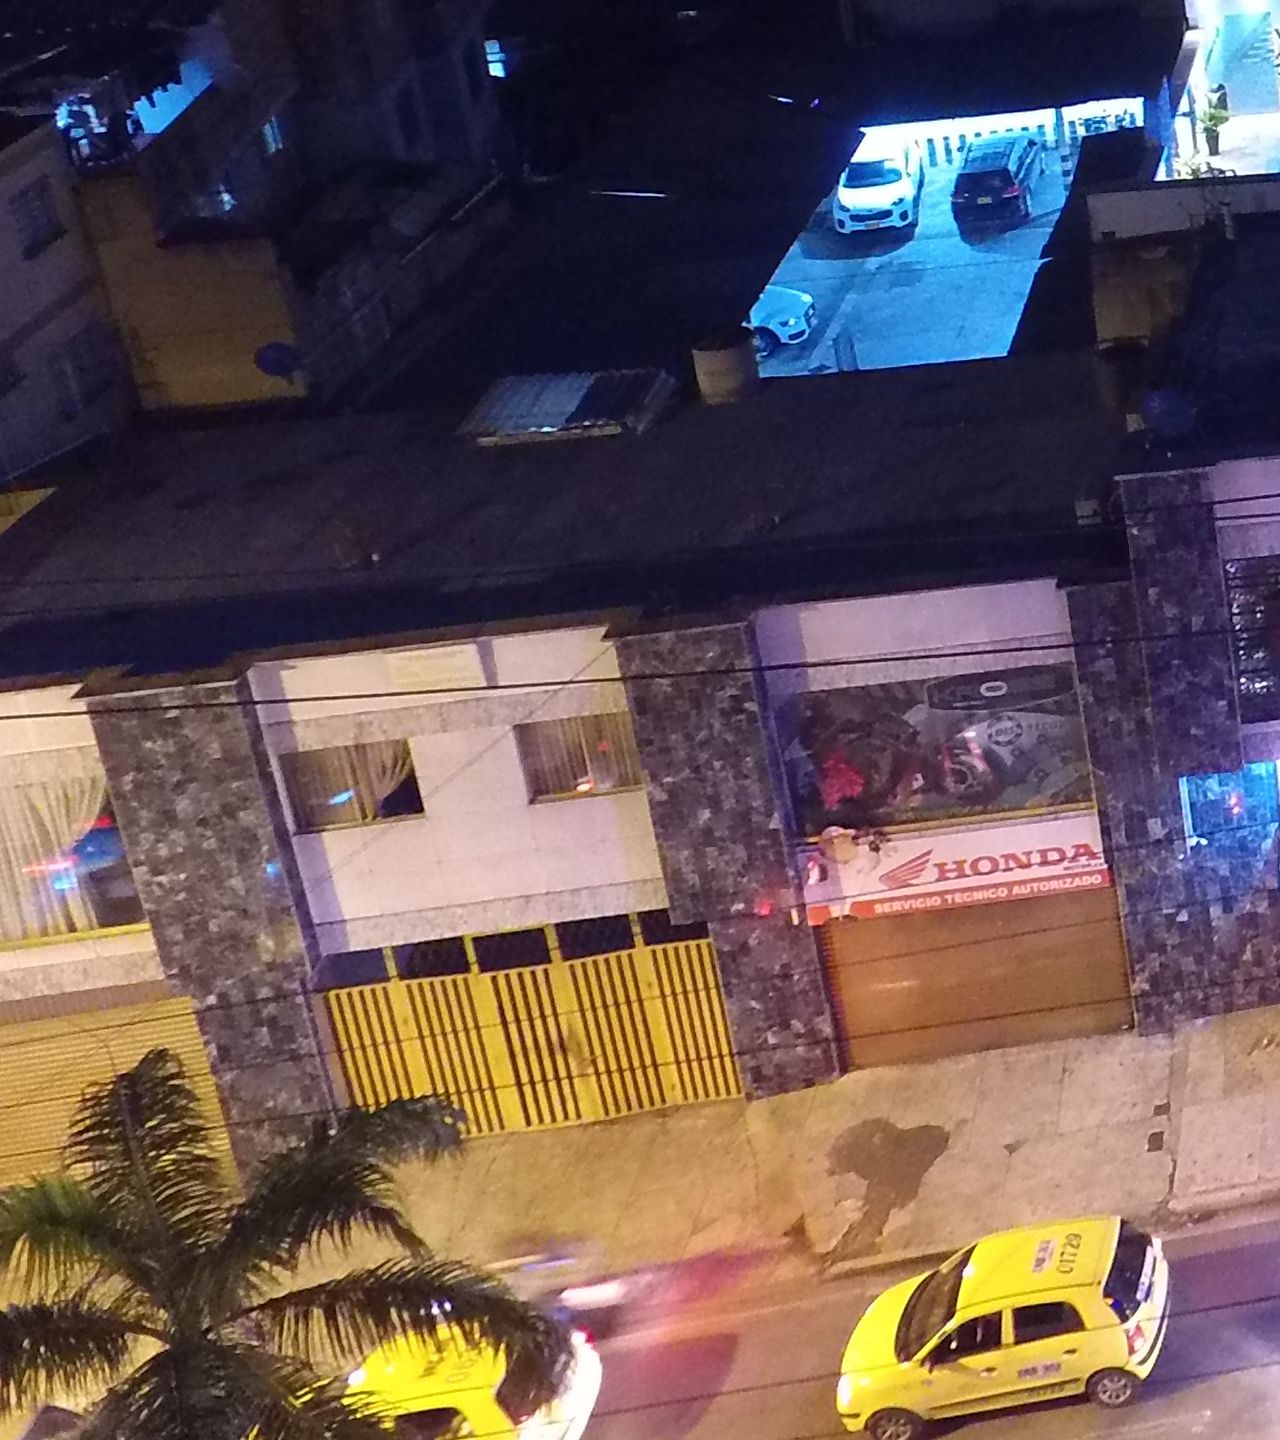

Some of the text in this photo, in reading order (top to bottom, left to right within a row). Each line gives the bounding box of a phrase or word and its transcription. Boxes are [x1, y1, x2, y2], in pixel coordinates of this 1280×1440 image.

[932, 842, 1101, 881] HONDA
[873, 897, 941, 915] SERVICIO
[1012, 873, 1104, 896] AUTORIZADO
[1056, 1233, 1082, 1274] 01729
